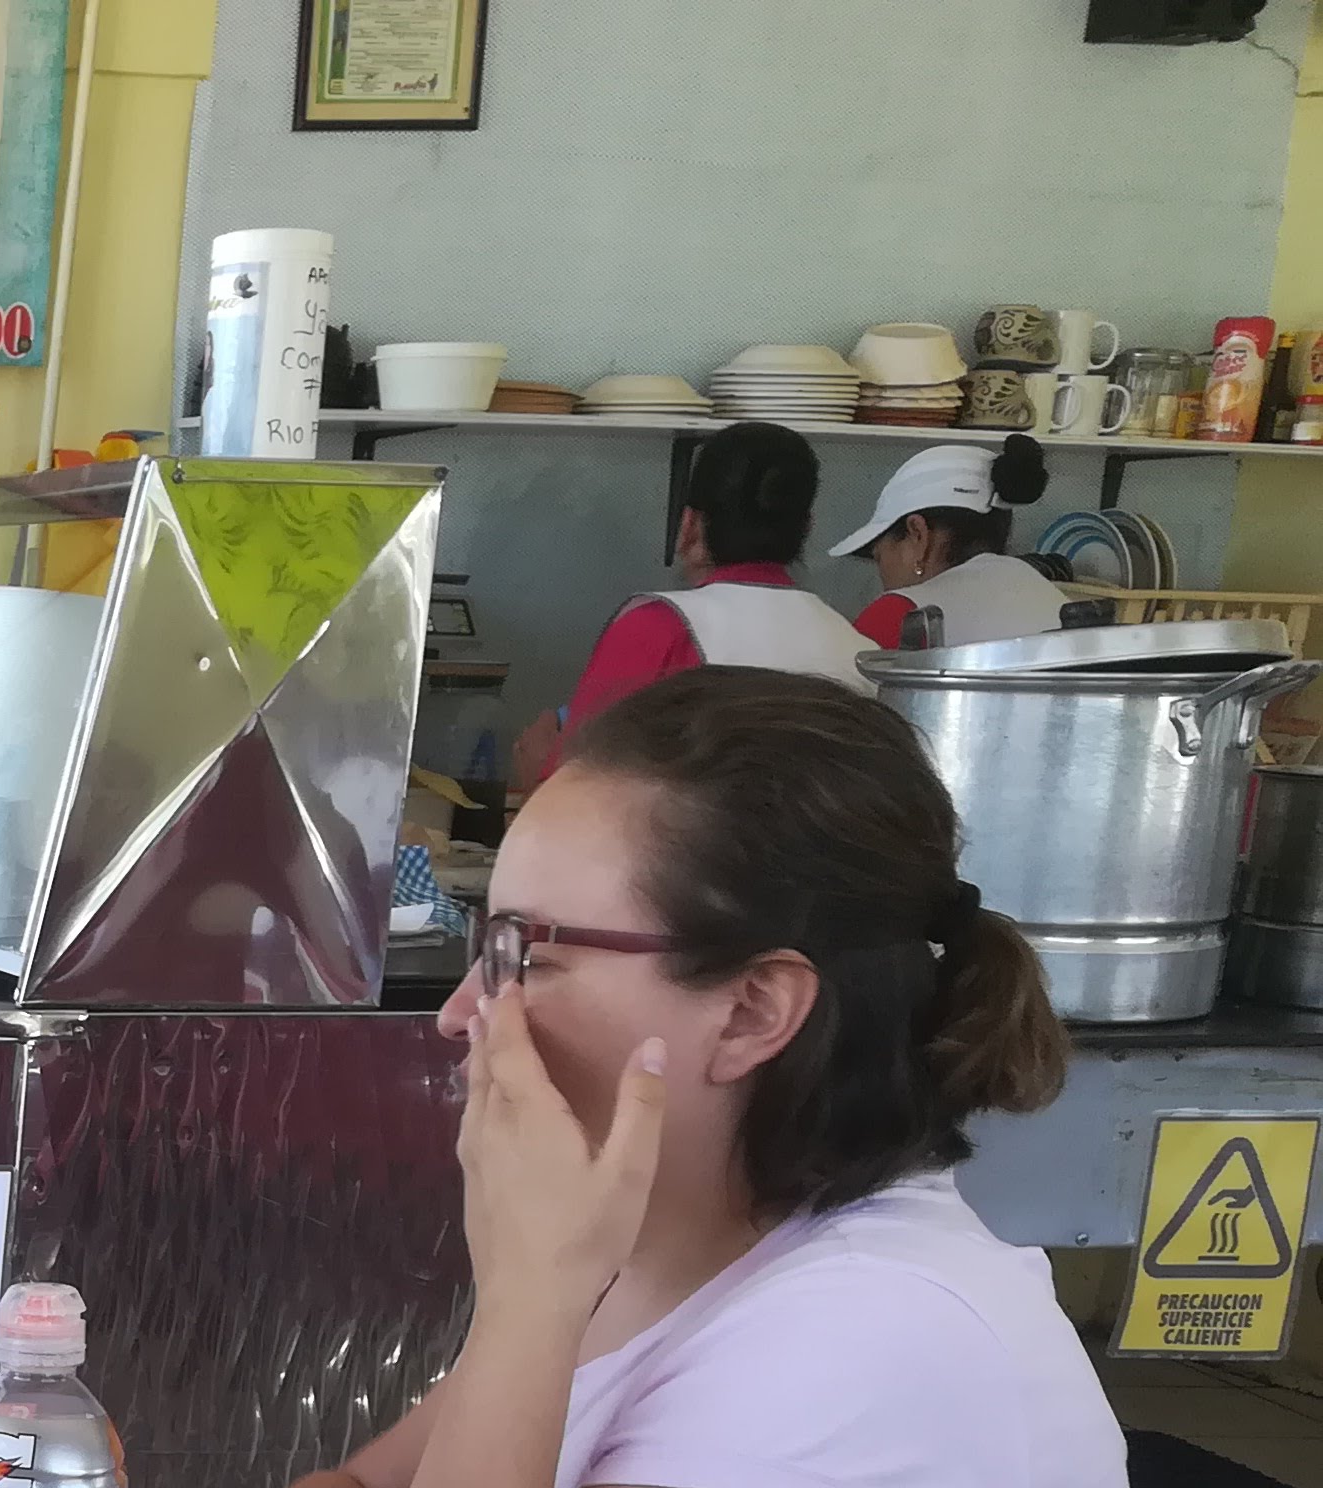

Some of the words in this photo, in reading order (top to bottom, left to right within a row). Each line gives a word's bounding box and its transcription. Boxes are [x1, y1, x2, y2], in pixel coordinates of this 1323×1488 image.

[1156, 1294, 1263, 1311] PRECAUCION
[1158, 1311, 1253, 1328] SUPERFICIE
[1163, 1329, 1242, 1345] CALIENTE
